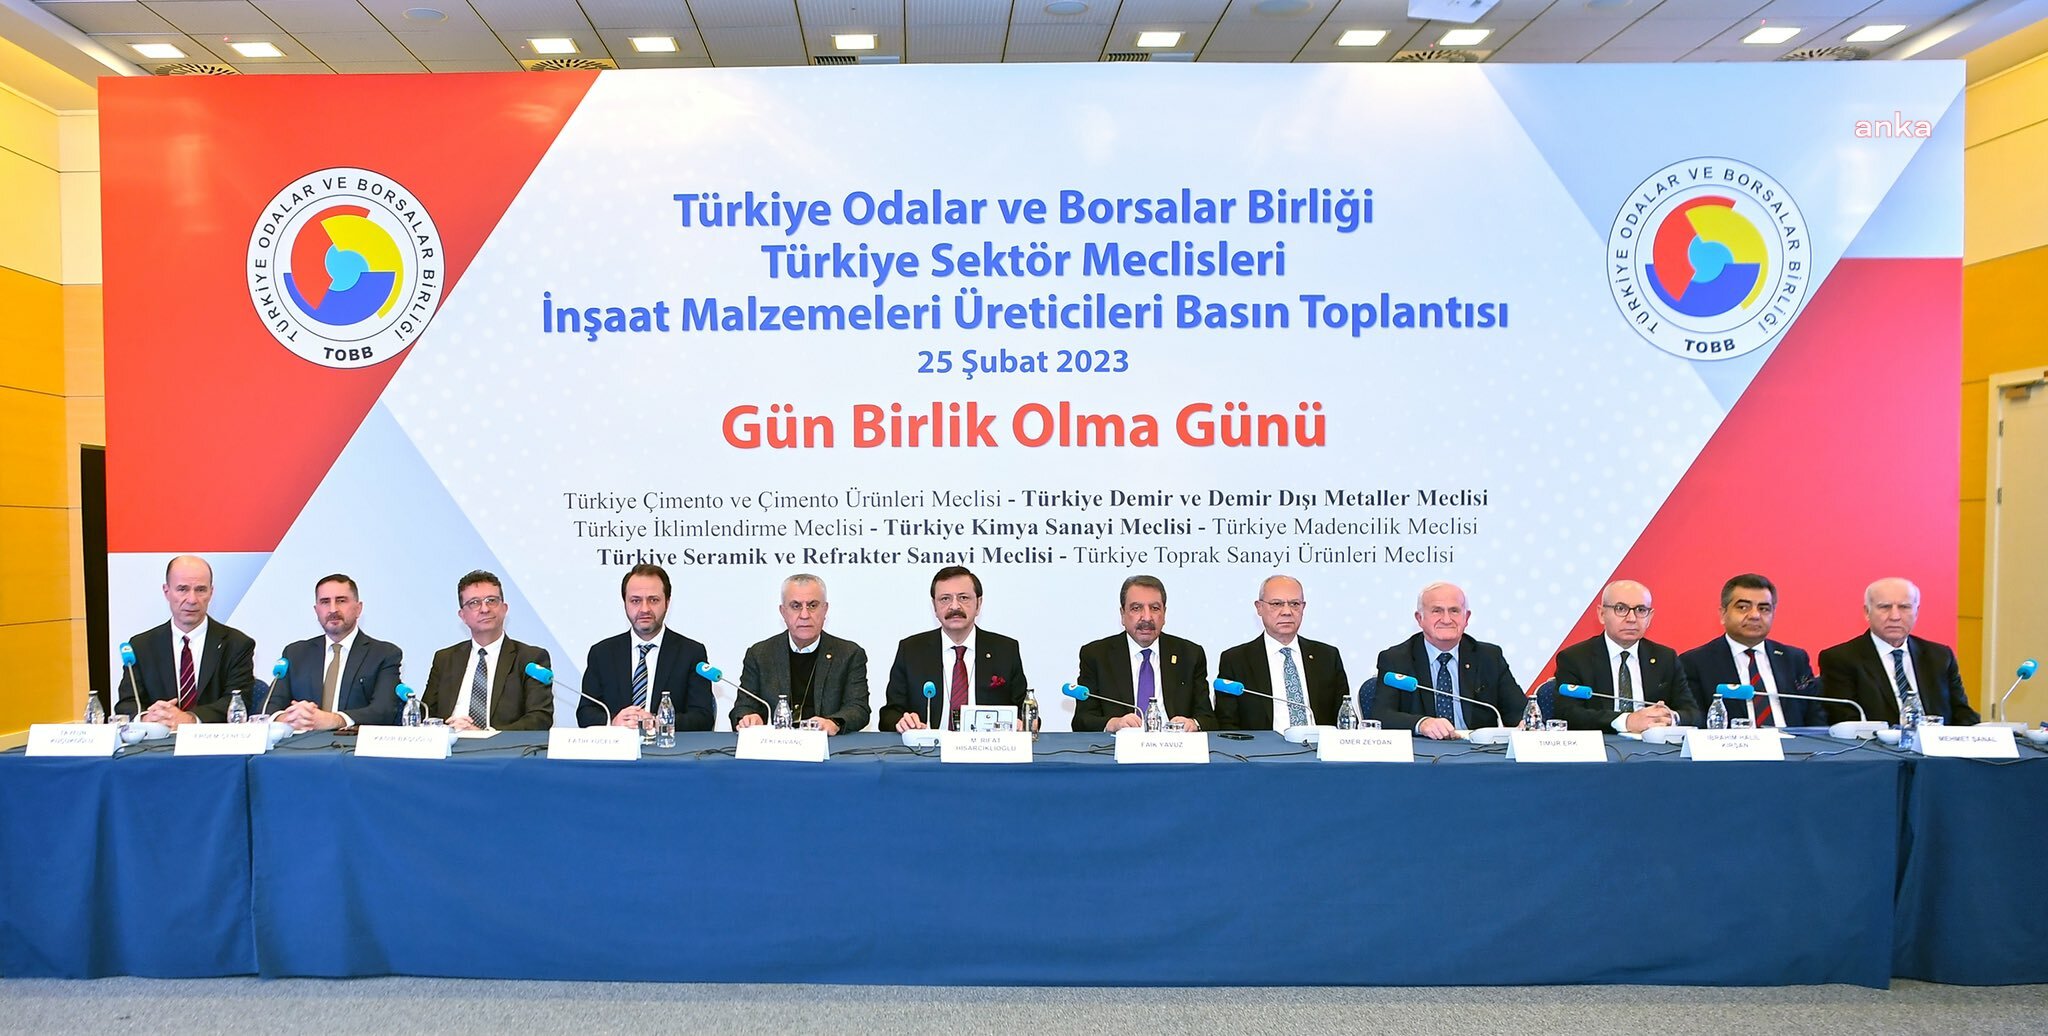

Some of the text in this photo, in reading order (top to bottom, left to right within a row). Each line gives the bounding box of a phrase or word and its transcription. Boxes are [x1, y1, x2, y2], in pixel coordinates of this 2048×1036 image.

[673, 188, 1373, 236] Türkiye Odalar ve Borsalar Birliği
[255, 177, 436, 342] TÜRKİYE ODALAR VE BORSALAR BİRLİĞİ
[761, 240, 1285, 283] Türkiye Sektör Meclisleri
[1615, 167, 1802, 334] TÜRKİYE ODALAR VE BORSALAR BİRLİĞİ
[543, 289, 1508, 337] İnşaat Malzemeleri Üreticileri Basın Toplantısı
[324, 346, 373, 361] TOBB
[918, 348, 1128, 380] 25 Şubat 2023
[1684, 339, 1736, 353] TOBB
[722, 401, 1325, 449] Gün Birlik Olma Günü
[563, 492, 637, 513] Türkiye
[644, 492, 724, 513] Çimento
[730, 496, 752, 508] ve
[758, 491, 839, 512] Çimento
[846, 487, 924, 508] Ürünleri
[932, 490, 1001, 507] Meclisi
[1022, 490, 1103, 511] Türkiye
[1110, 490, 1173, 506] Demir
[1180, 494, 1201, 506] ve
[1209, 490, 1272, 506] Demir
[1279, 490, 1317, 510] Dışı
[1325, 490, 1410, 506] Metaller
[1417, 489, 1488, 506] Meclisi
[574, 520, 647, 541] Türkiye
[654, 517, 787, 537] İklimlendirme
[795, 519, 863, 536] Meclisi
[884, 519, 964, 540] Türkiye
[972, 519, 1039, 540] Kimya
[1046, 518, 1113, 539] Sanayi
[1121, 518, 1192, 535] Meclisi
[1212, 518, 1287, 539] Türkiye
[1294, 517, 1401, 535] Madencilik
[1409, 517, 1478, 535] Meclisi
[597, 547, 677, 567] Türkiye
[684, 547, 767, 565] Seramik
[774, 552, 795, 565] ve
[802, 547, 901, 565] Refrakter
[908, 547, 975, 566] Sanayi
[982, 546, 1053, 564] Meclisi
[1074, 546, 1148, 567] Türkiye
[1154, 546, 1220, 567] Toprak
[1227, 546, 1290, 567] Sanayi
[1298, 543, 1377, 564] Ürünleri
[1385, 546, 1454, 564] Meclisi
